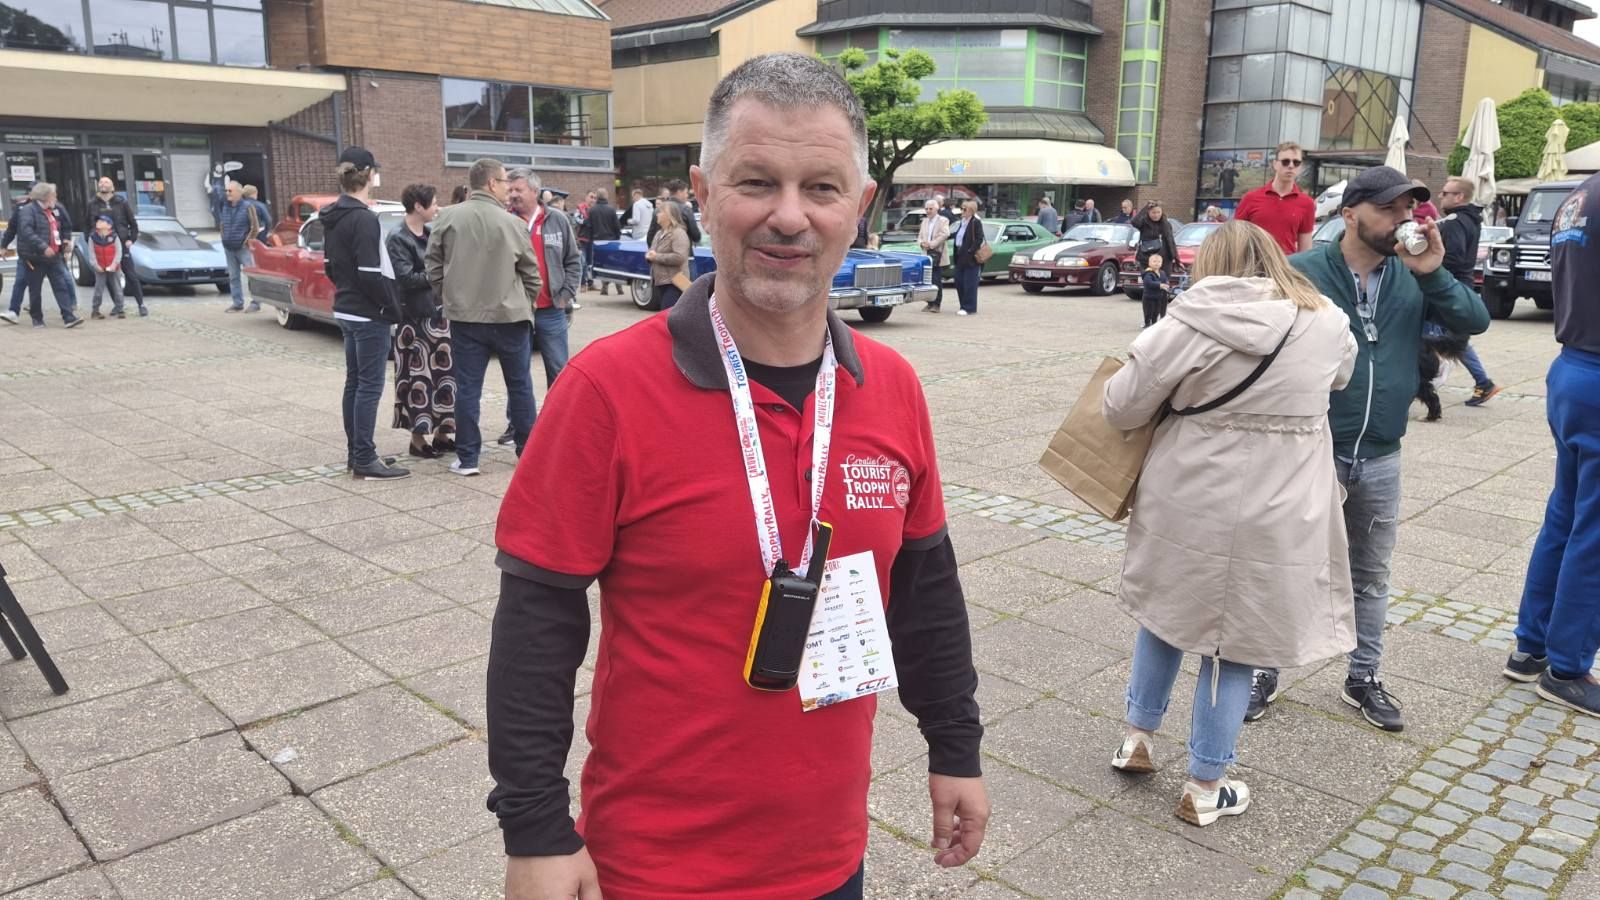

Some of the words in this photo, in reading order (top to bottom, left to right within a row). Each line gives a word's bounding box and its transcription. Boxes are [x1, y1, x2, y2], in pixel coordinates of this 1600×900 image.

[728, 349, 747, 389] TOURIST
[840, 463, 891, 480] TOURIST
[843, 478, 890, 494] TROPHY
